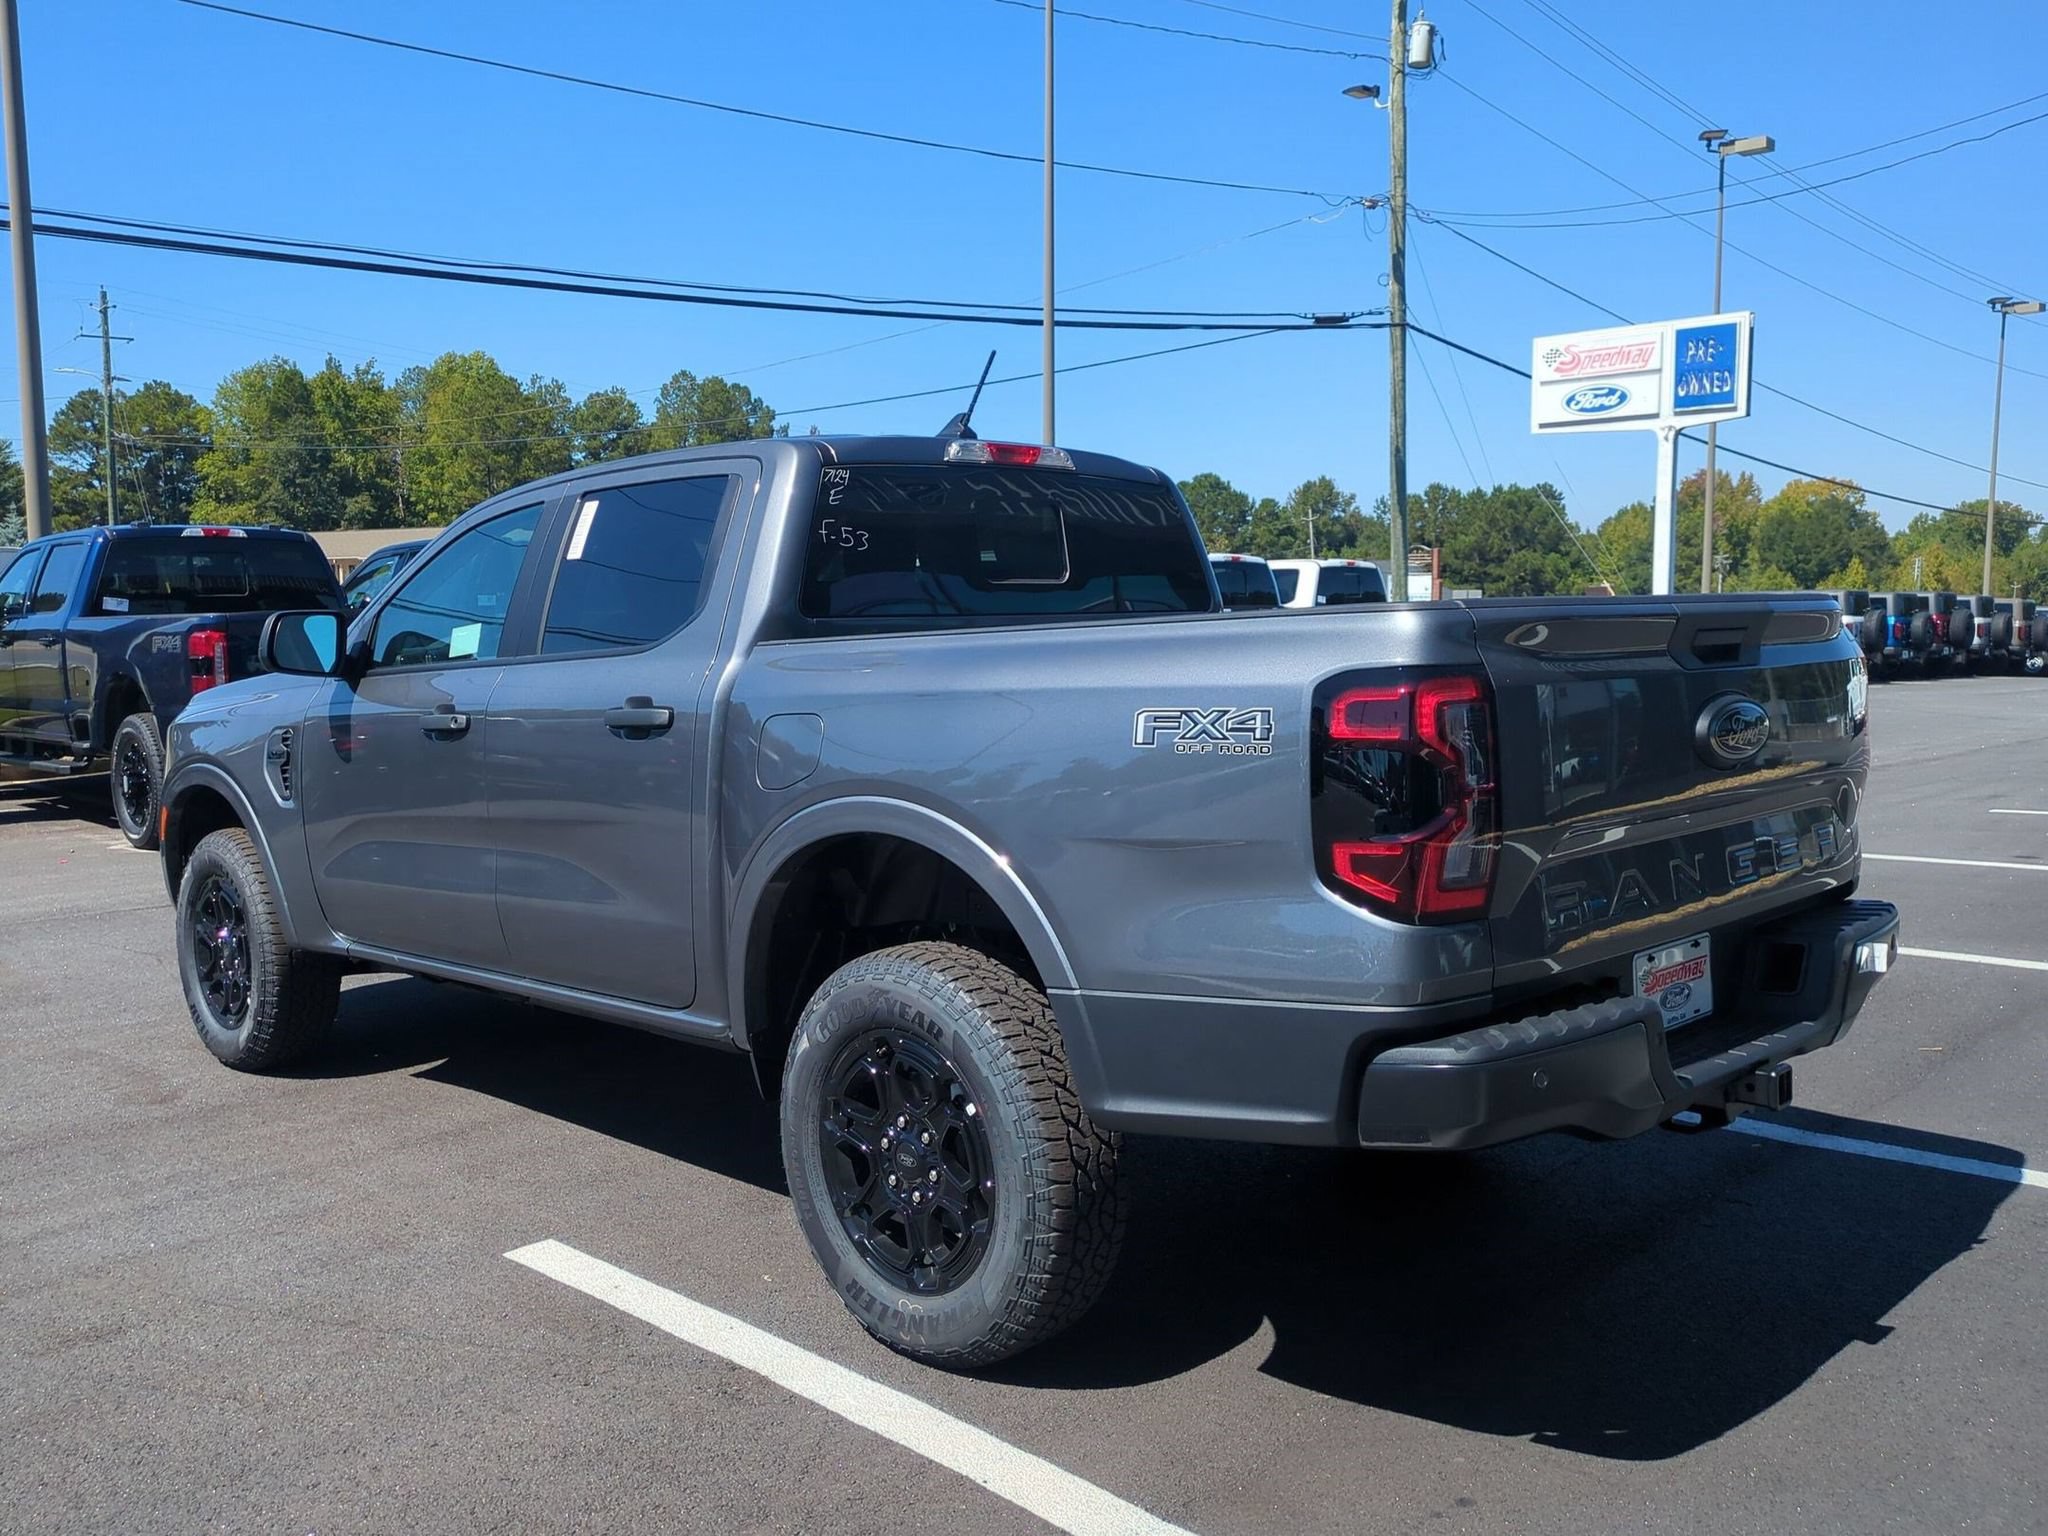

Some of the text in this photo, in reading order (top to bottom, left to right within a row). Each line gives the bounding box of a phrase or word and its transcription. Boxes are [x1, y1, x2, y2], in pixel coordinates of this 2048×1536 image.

[1554, 342, 1656, 375] Speedway
[1677, 369, 1732, 397] OWNED
[1567, 387, 1623, 413] Ford
[829, 485, 845, 505] E
[152, 635, 182, 653] FX4
[1132, 707, 1274, 748] FX4
[1174, 743, 1213, 754] OFF
[1218, 744, 1272, 756] ROAD
[1643, 956, 1707, 994] Speedway
